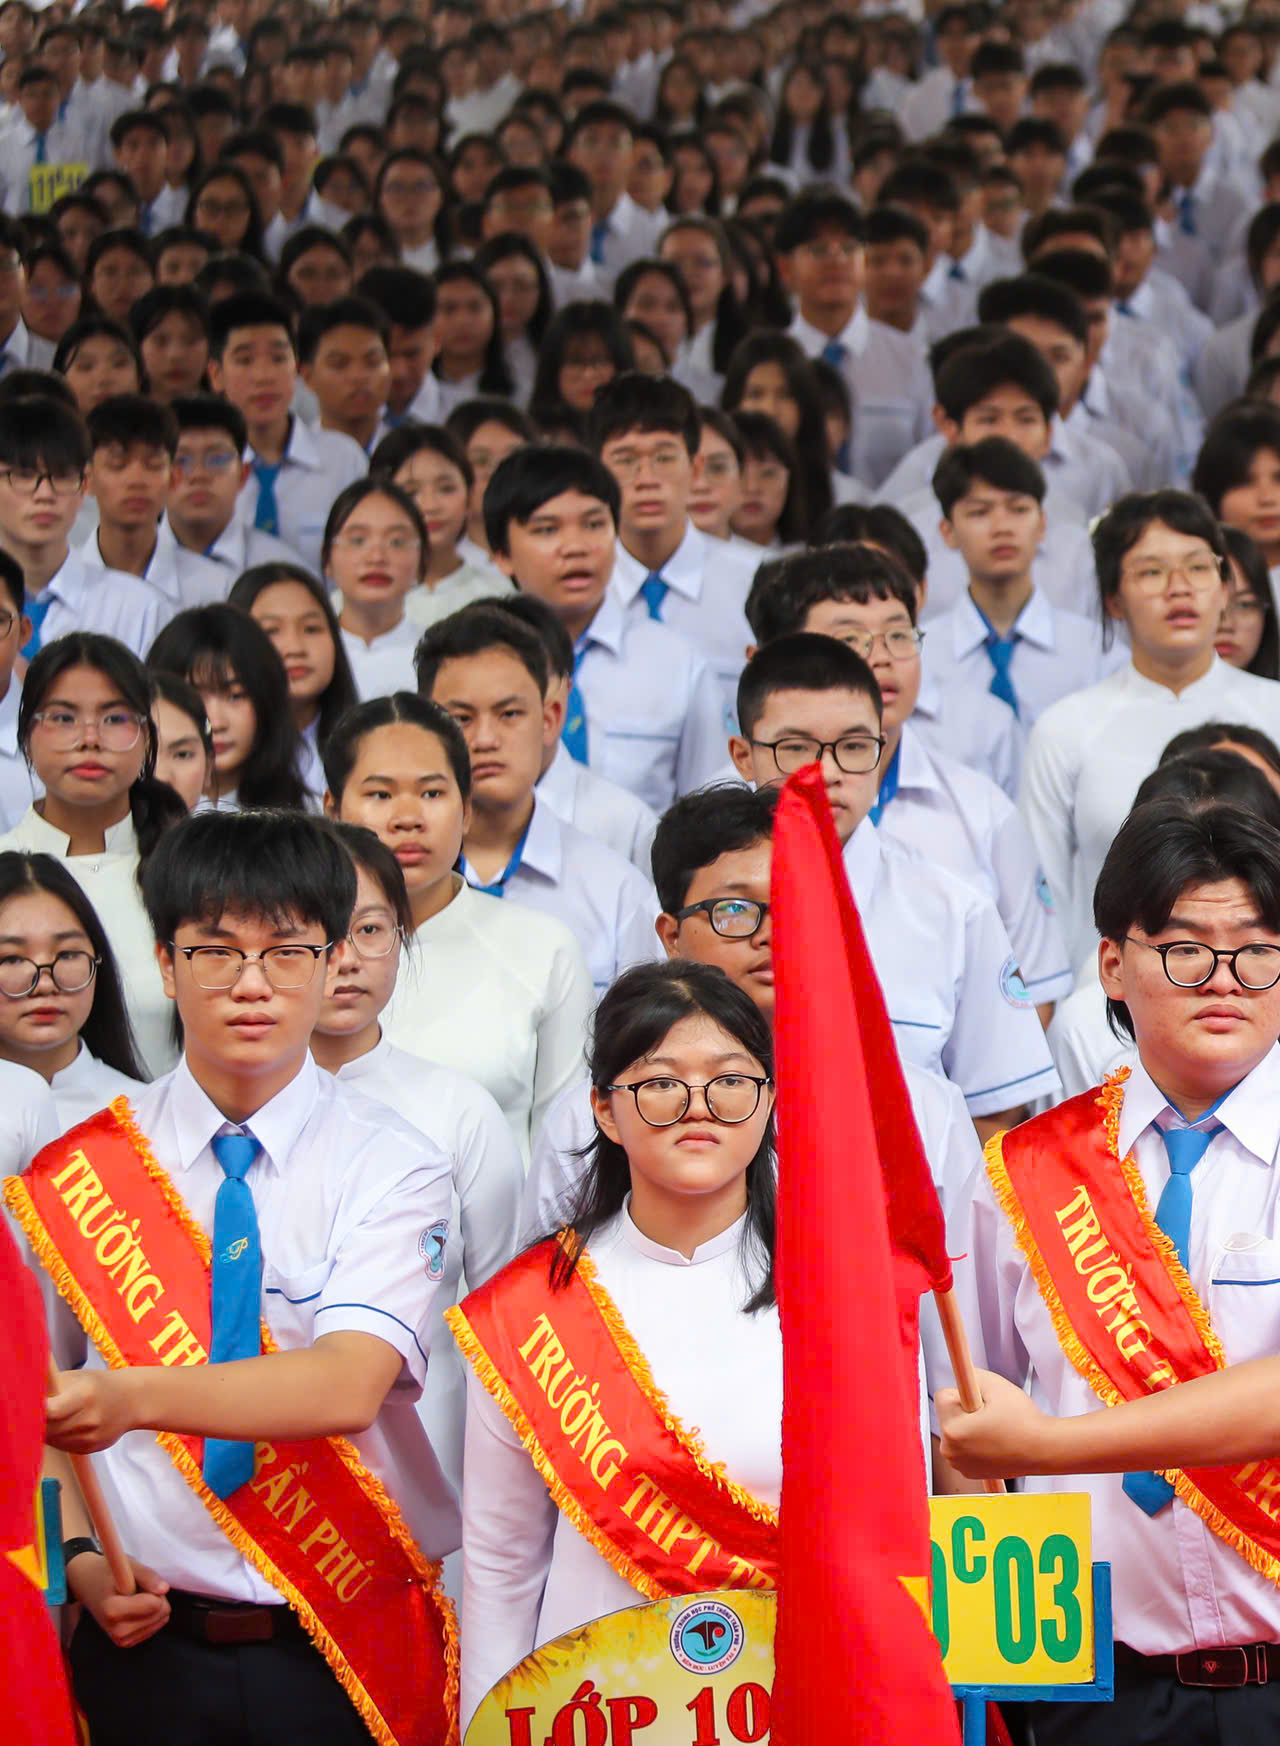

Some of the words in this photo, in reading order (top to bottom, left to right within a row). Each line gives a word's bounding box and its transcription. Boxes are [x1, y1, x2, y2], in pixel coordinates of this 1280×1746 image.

[1055, 1185, 1152, 1362] TRƯỜNG
[51, 1148, 165, 1325] TRƯỜNG
[148, 1310, 210, 1367] TH
[249, 1441, 318, 1534] RẦN
[299, 1517, 375, 1602] PHÚ
[518, 1313, 629, 1491] TRƯỜNG
[620, 1472, 722, 1576] THPT
[716, 1555, 777, 1589] TR
[931, 1516, 1082, 1664] C03
[505, 1680, 658, 1746] LỚP
